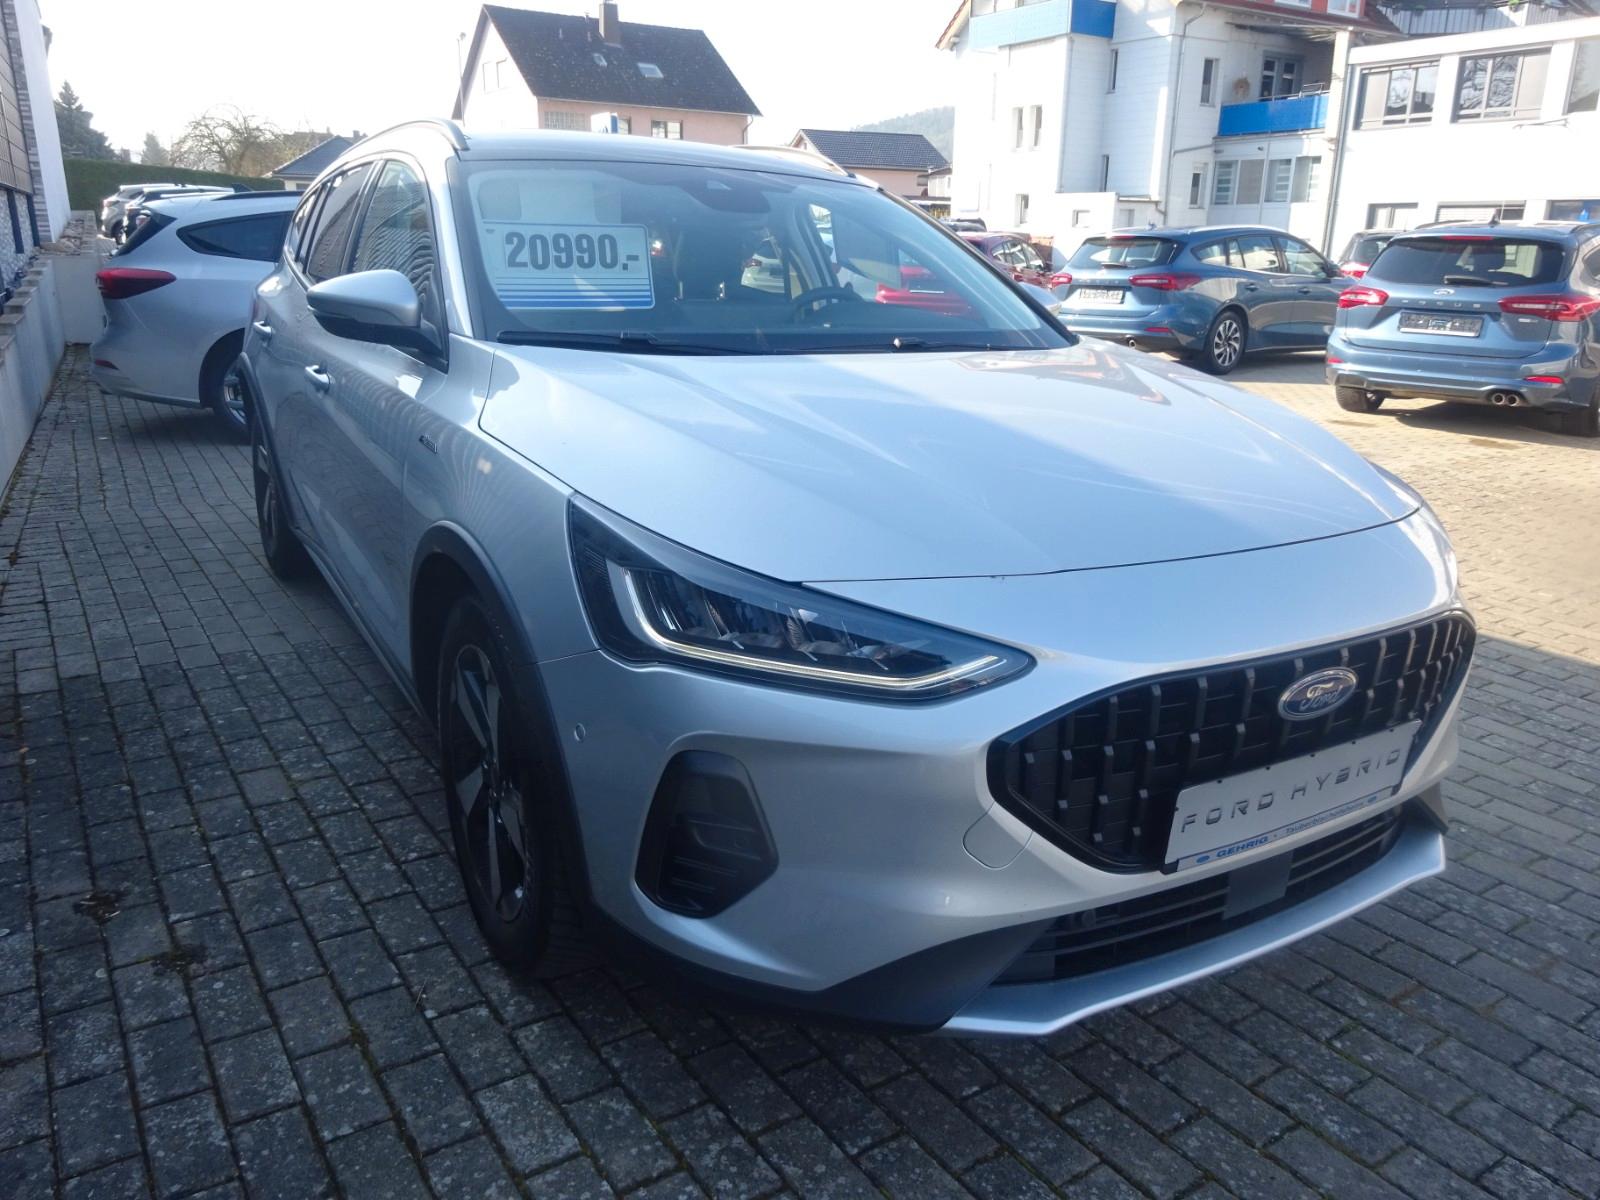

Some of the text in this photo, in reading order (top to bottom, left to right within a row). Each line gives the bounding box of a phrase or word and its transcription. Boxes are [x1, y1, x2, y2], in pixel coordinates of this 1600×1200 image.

[1299, 681, 1344, 711] Ford
[1181, 792, 1275, 833] FORD
[1291, 749, 1401, 800] HYBRID
[1216, 835, 1269, 858] GEHRIG
